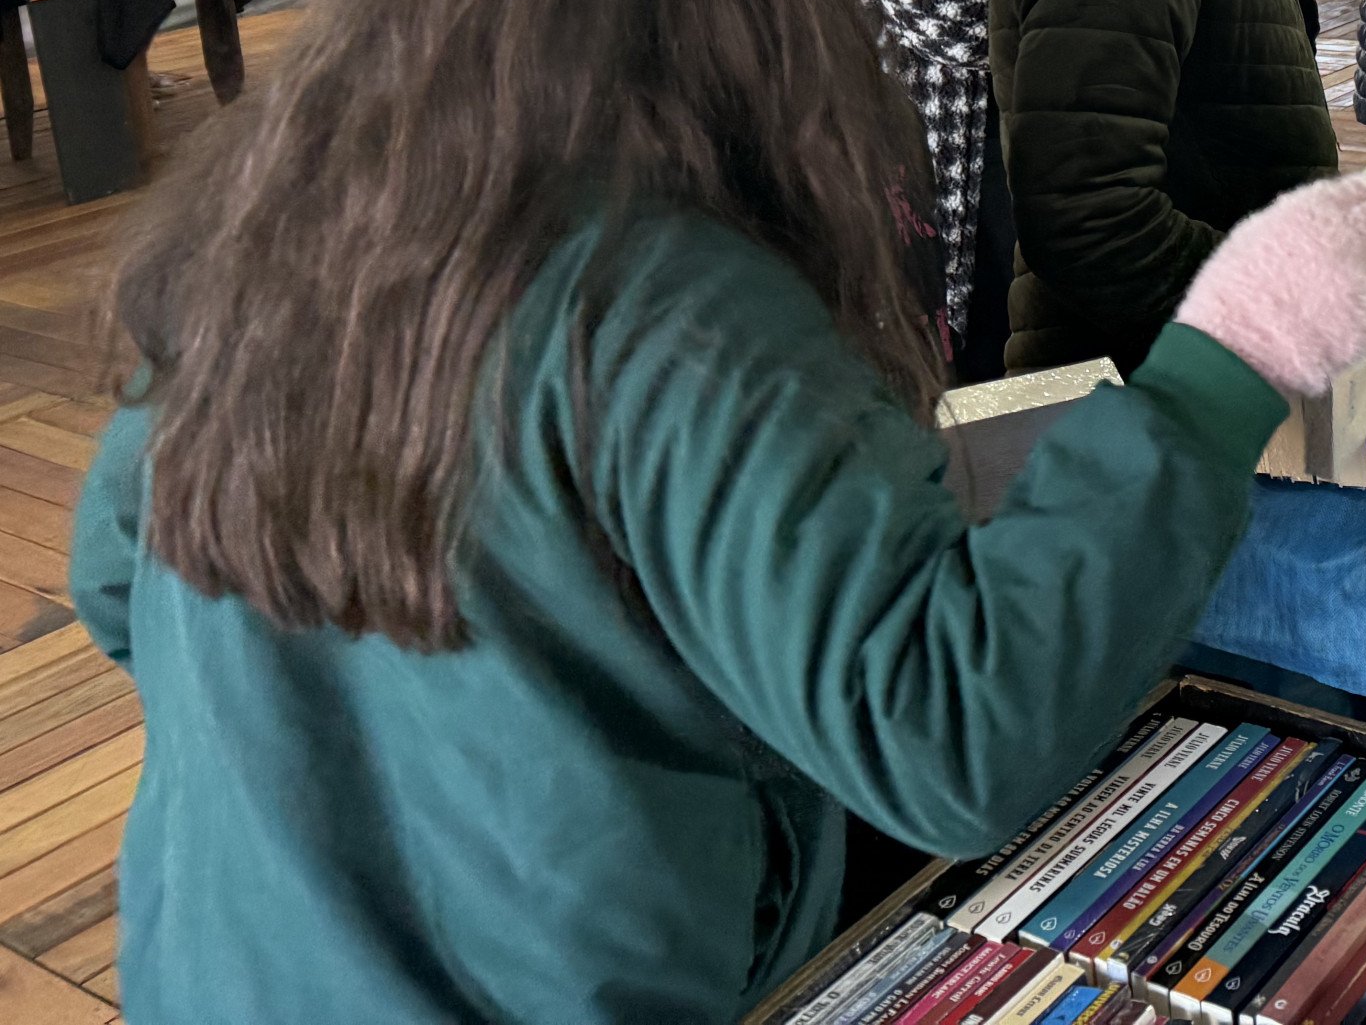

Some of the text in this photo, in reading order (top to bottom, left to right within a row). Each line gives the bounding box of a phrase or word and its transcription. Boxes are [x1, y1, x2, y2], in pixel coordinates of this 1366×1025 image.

[1004, 771, 1129, 883] VIAGEM AO CENTRO DA TERRA
[1028, 779, 1155, 894] VINTE MIL LÉGUAS SUBMARINAS
[1092, 799, 1178, 881] A ILHA MISTERIOSA
[1151, 830, 1175, 853] TERRA
[1331, 821, 1344, 834] O
[1121, 795, 1239, 913] CINCO SEMANAS EM UM BALÃO
[1248, 871, 1263, 887] A
[1223, 900, 1236, 913] DO
[1187, 909, 1229, 953] TESOURO
[930, 945, 993, 999] MAURICE LEBLANC
[949, 974, 981, 1003] Carroll
